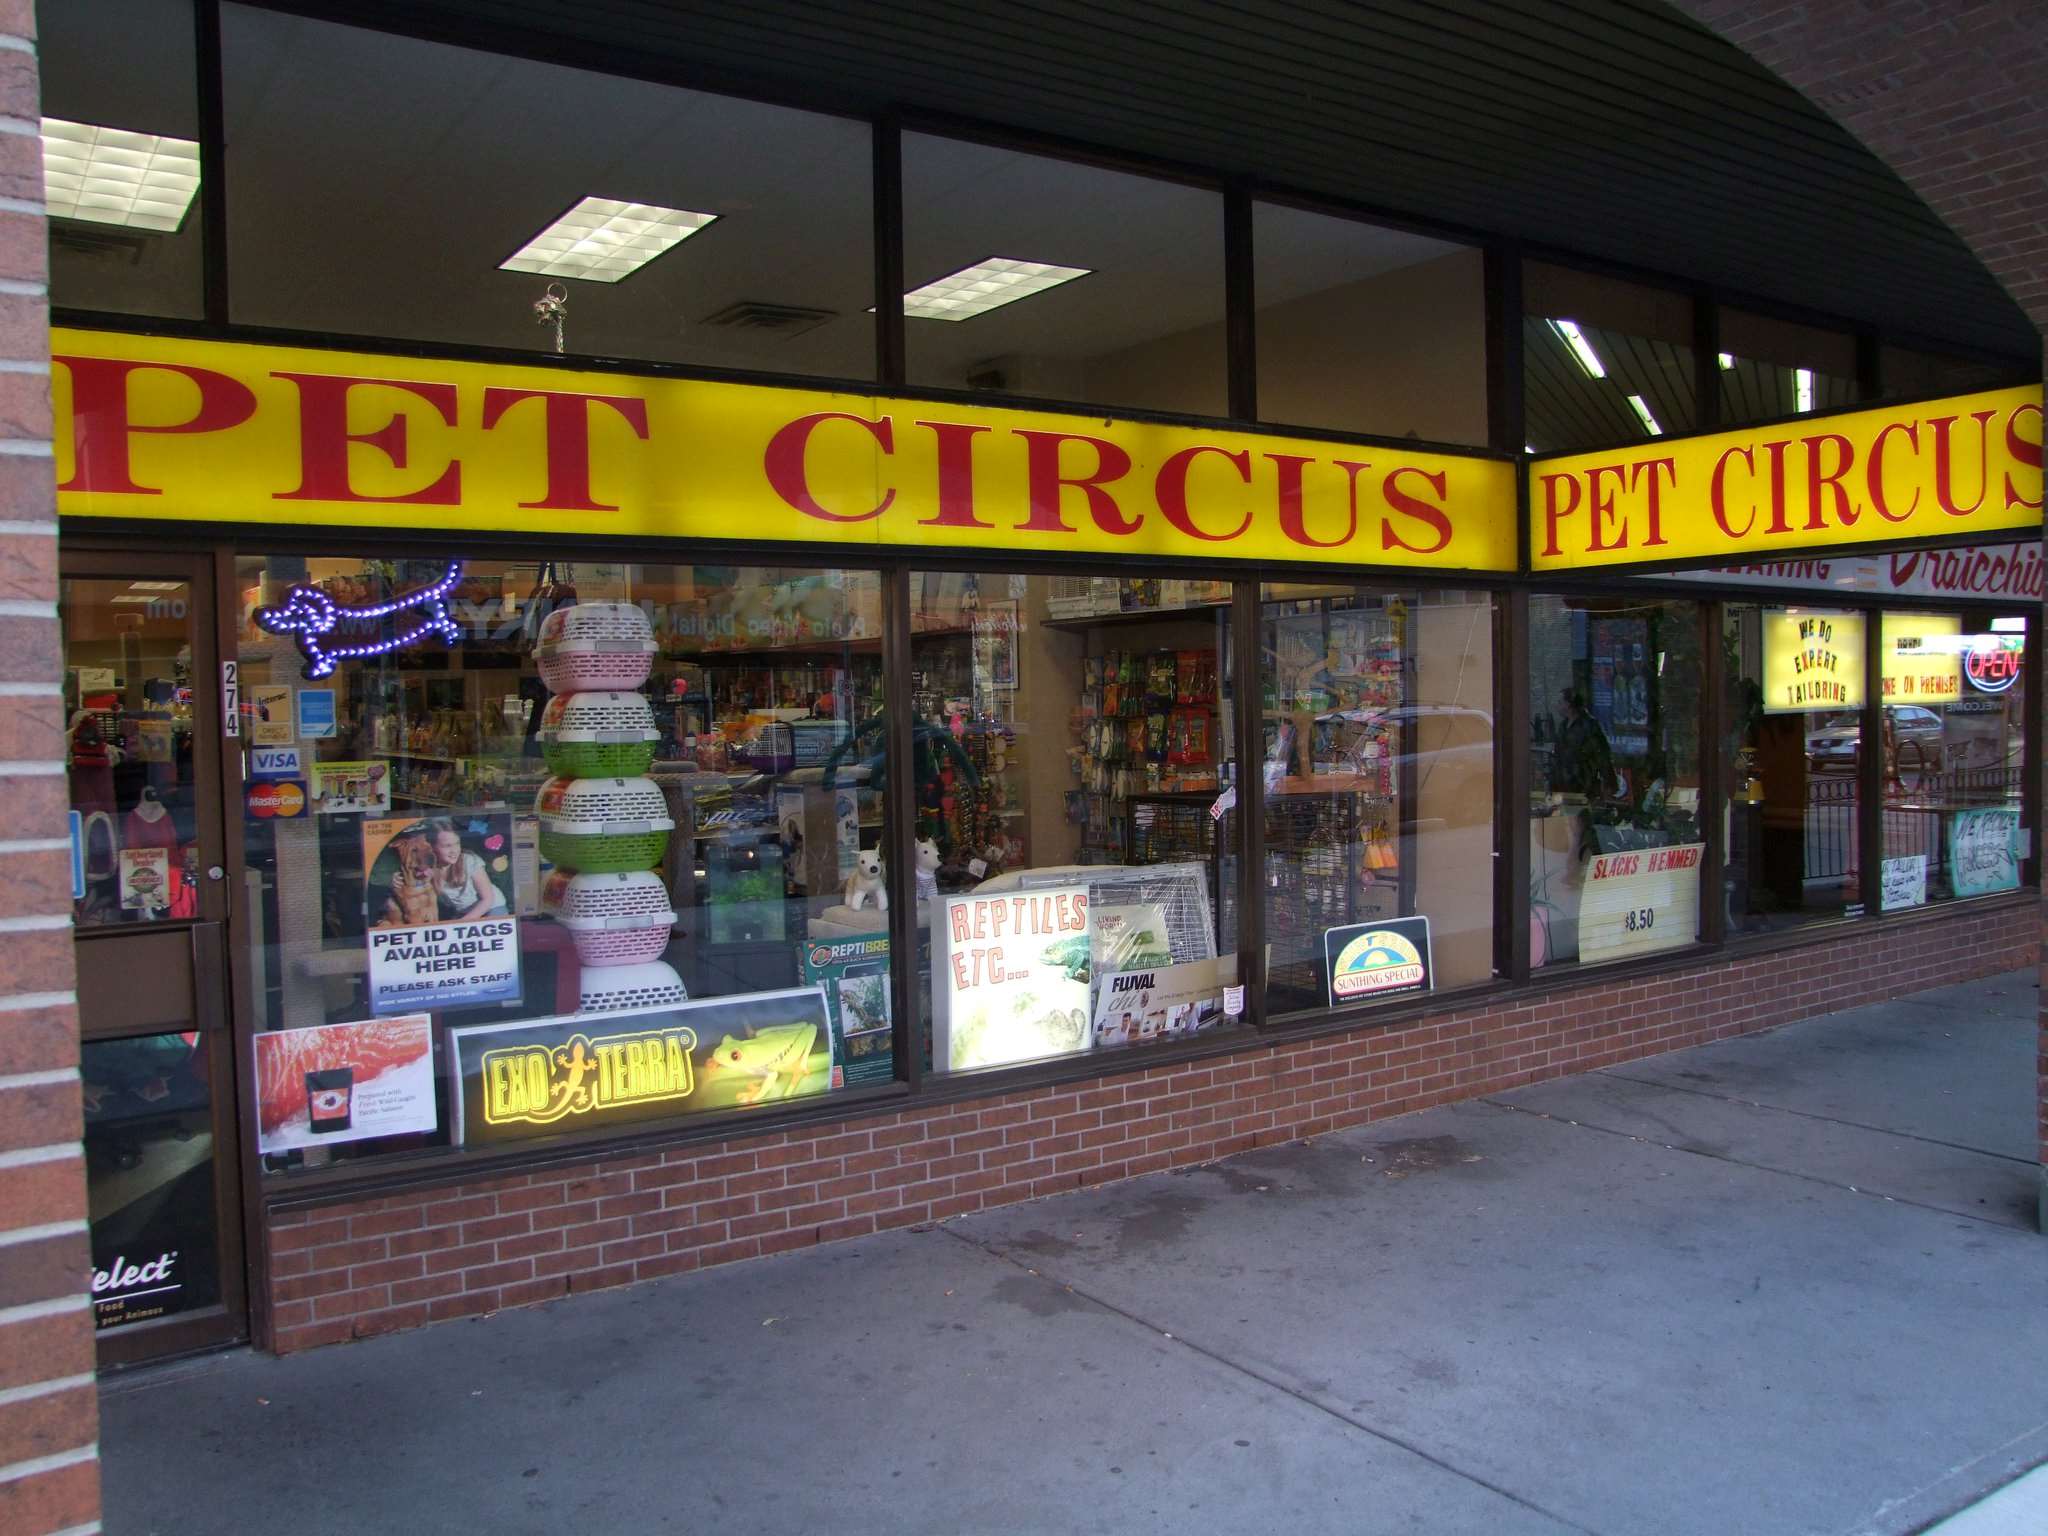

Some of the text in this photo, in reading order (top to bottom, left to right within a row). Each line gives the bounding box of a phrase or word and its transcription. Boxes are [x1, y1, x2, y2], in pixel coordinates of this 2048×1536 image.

[52, 354, 1454, 555] PET CIRCUS
[1539, 403, 2043, 557] PET CIRCUS
[1798, 619, 1832, 643] WE DO
[1794, 649, 1838, 674] EXPERT
[1969, 650, 2018, 678] OPEN
[1787, 680, 1847, 706] TAILORING
[1920, 675, 1958, 694] PREMISES
[225, 663, 238, 736] 274
[256, 753, 298, 768] VISA
[249, 795, 304, 808] MasterCard
[1594, 848, 1698, 881] SLACKS HEMMED
[950, 894, 1088, 943] REPTILES
[1625, 907, 1654, 932] $8.50
[374, 922, 513, 948] PET ID TAGS
[384, 938, 505, 962] AVAILABLE
[416, 956, 477, 974] HERE
[951, 946, 1030, 991] ETC...
[379, 972, 513, 995] PLEASE ASK STAFF
[1112, 973, 1155, 993] FLUVAL
[1337, 967, 1420, 990] SUNTHING SPECIAL
[492, 1048, 549, 1117] EXO
[92, 1252, 175, 1292] elect
[100, 1300, 124, 1312] Food
